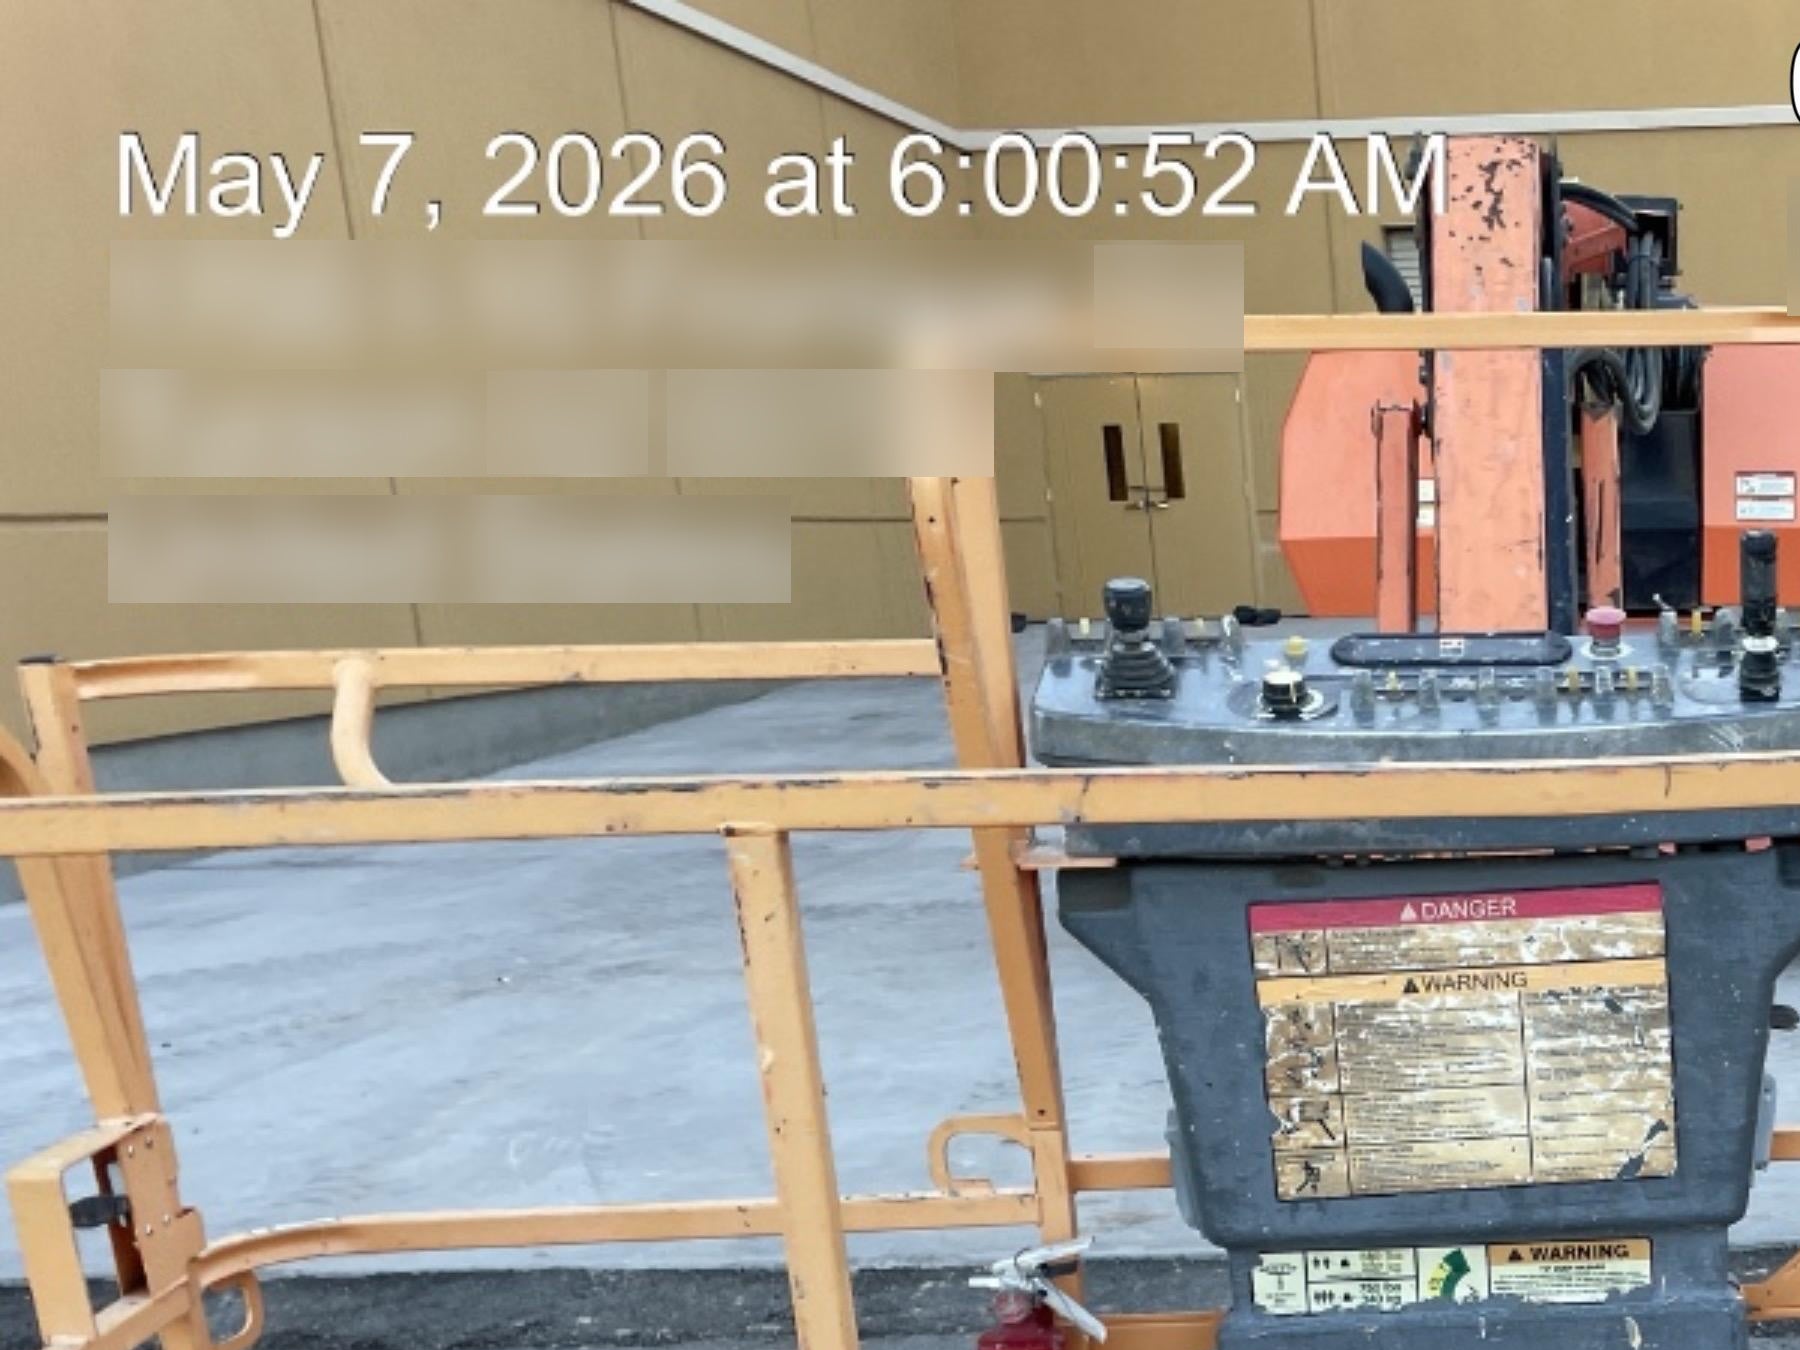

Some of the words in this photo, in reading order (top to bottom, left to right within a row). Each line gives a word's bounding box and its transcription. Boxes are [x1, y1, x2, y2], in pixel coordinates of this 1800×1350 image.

[1420, 896, 1517, 920] DANGER
[1420, 971, 1528, 993] WARNING
[1529, 1243, 1630, 1262] WARNING
